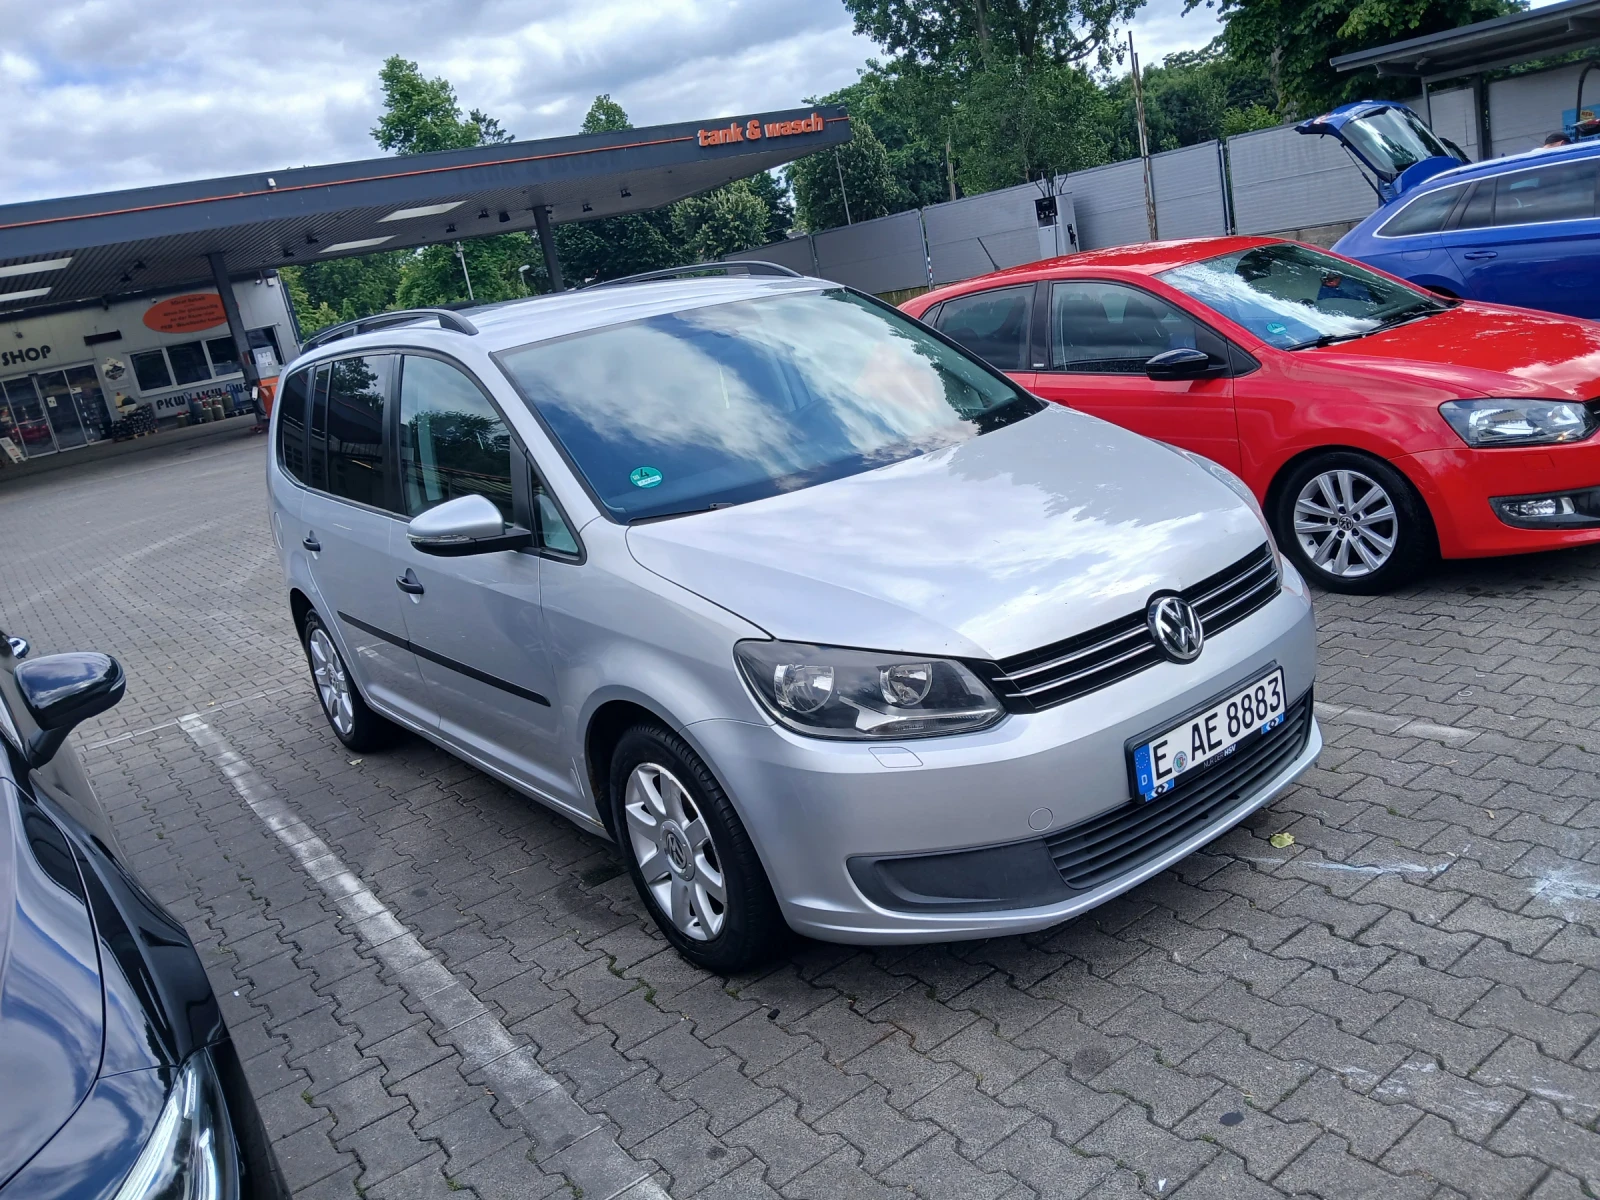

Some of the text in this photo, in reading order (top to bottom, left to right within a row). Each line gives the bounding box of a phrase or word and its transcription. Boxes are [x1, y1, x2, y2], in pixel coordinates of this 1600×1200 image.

[697, 112, 824, 147] tank & wasch
[1, 344, 52, 367] SHOP
[156, 394, 186, 410] PKW
[640, 469, 649, 478] 4
[1152, 676, 1281, 781] E AE 8883
[1224, 743, 1237, 757] HSV
